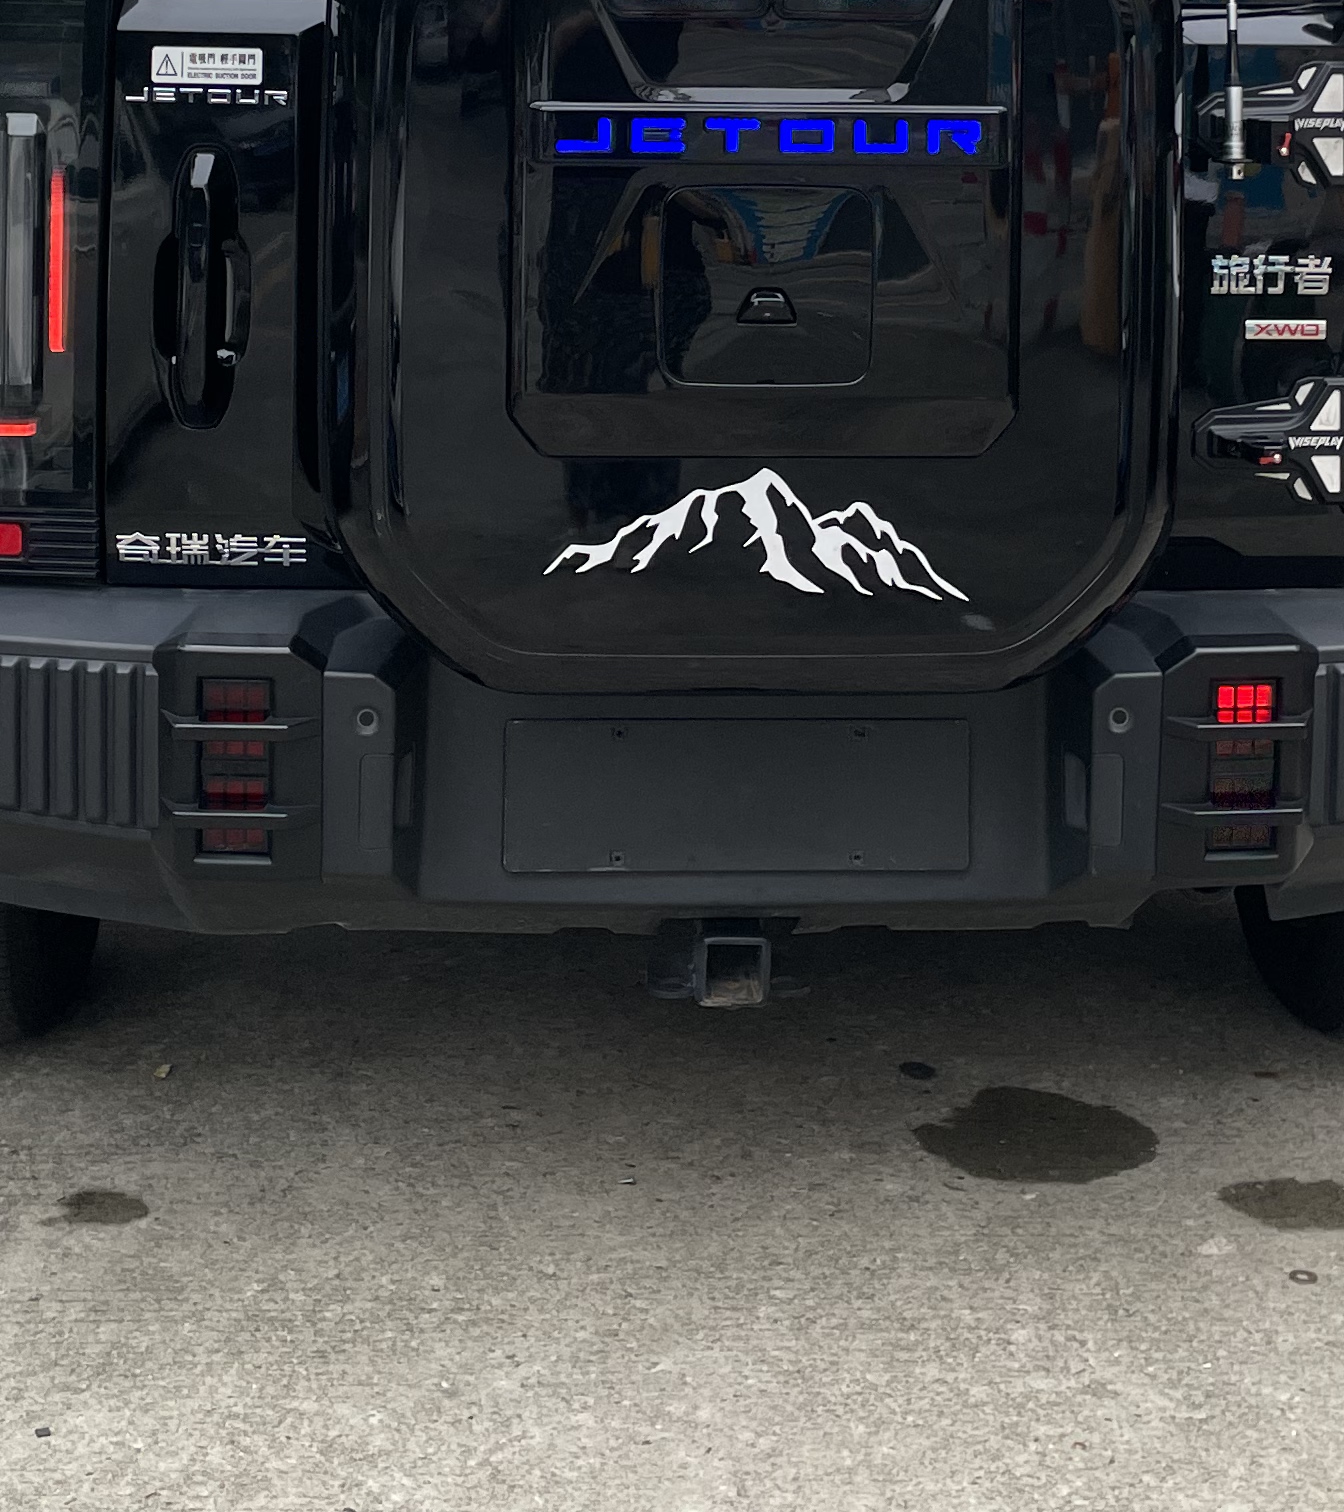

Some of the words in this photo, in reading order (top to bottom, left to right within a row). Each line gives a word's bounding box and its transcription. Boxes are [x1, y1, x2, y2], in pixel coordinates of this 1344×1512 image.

[240, 72, 257, 80] DOOR
[125, 86, 288, 106] JETOUR
[555, 116, 983, 156] JETOUR
[1209, 253, 1333, 296] 旅行者
[1253, 323, 1320, 337] XWD
[1288, 436, 1344, 450] WISEPLAY
[115, 531, 307, 566] 奇瑞汽车
